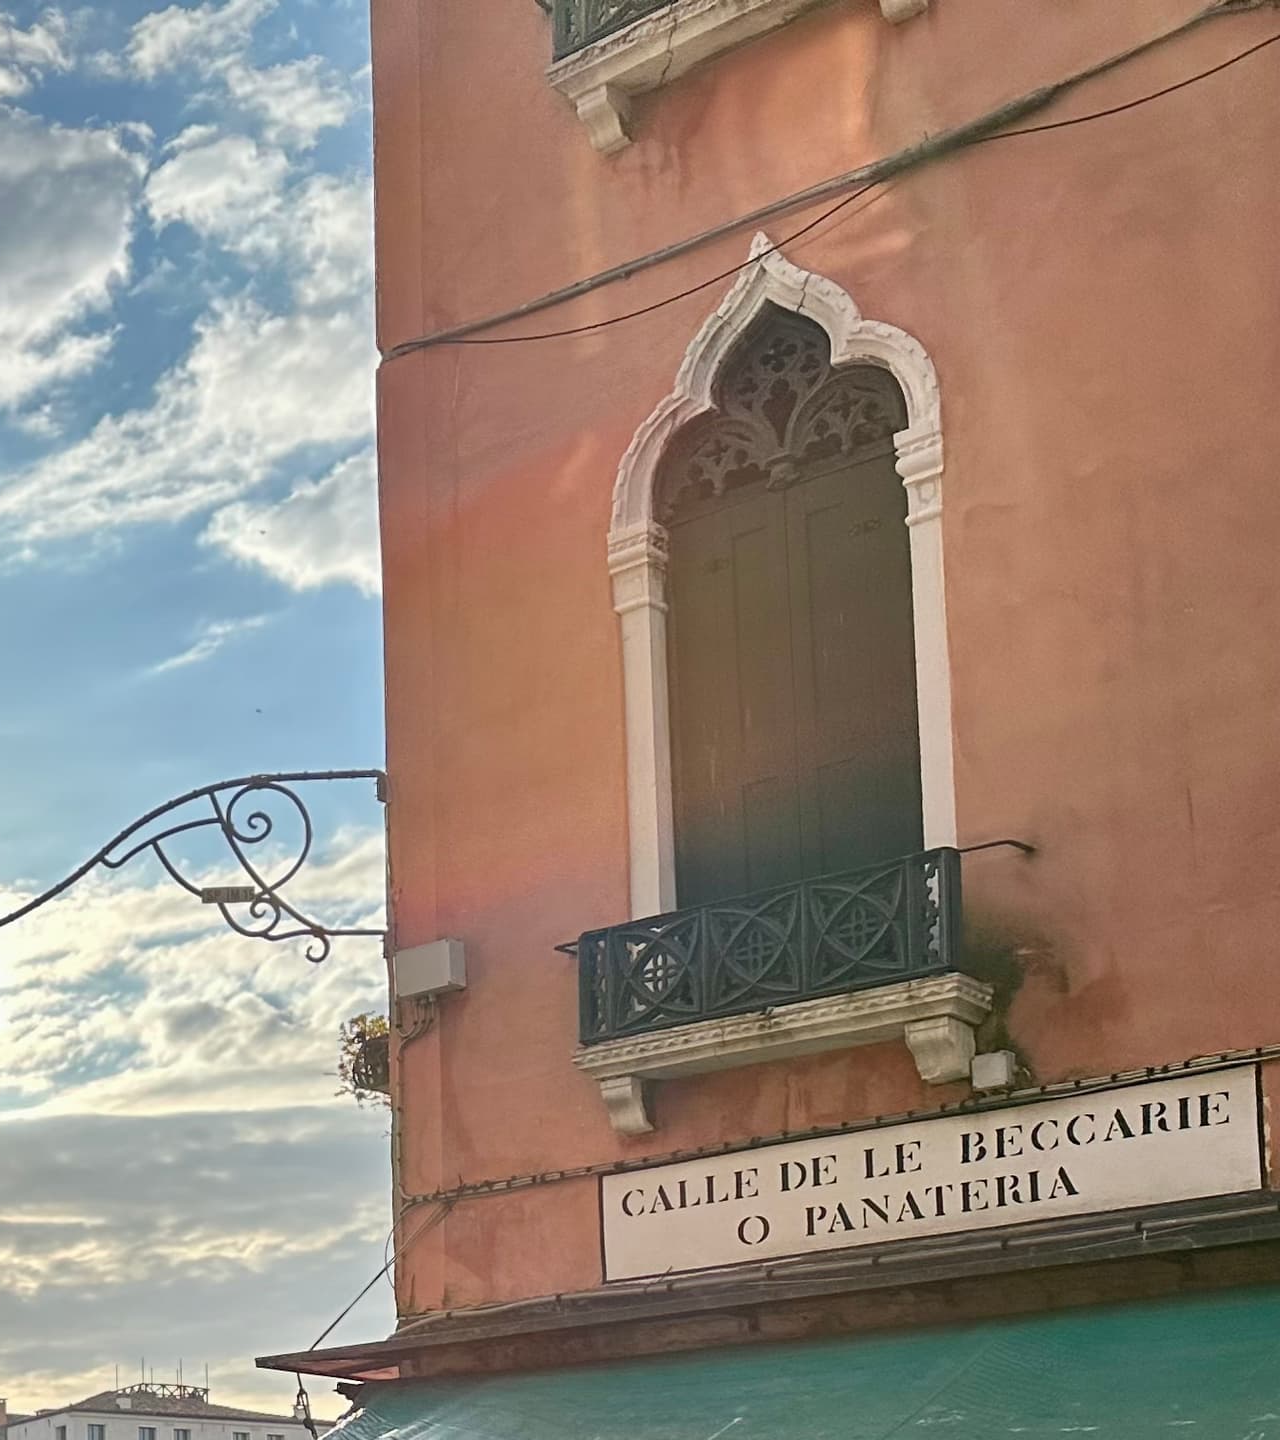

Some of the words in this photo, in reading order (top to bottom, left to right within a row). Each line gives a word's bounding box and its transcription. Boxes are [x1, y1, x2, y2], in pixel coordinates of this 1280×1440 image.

[621, 1167, 759, 1217] CALLE
[780, 1154, 838, 1193] DE
[863, 1140, 922, 1179] LE
[960, 1091, 1230, 1164] BECCARIE
[737, 1215, 770, 1245] O
[804, 1166, 1080, 1237] PANATERIA
